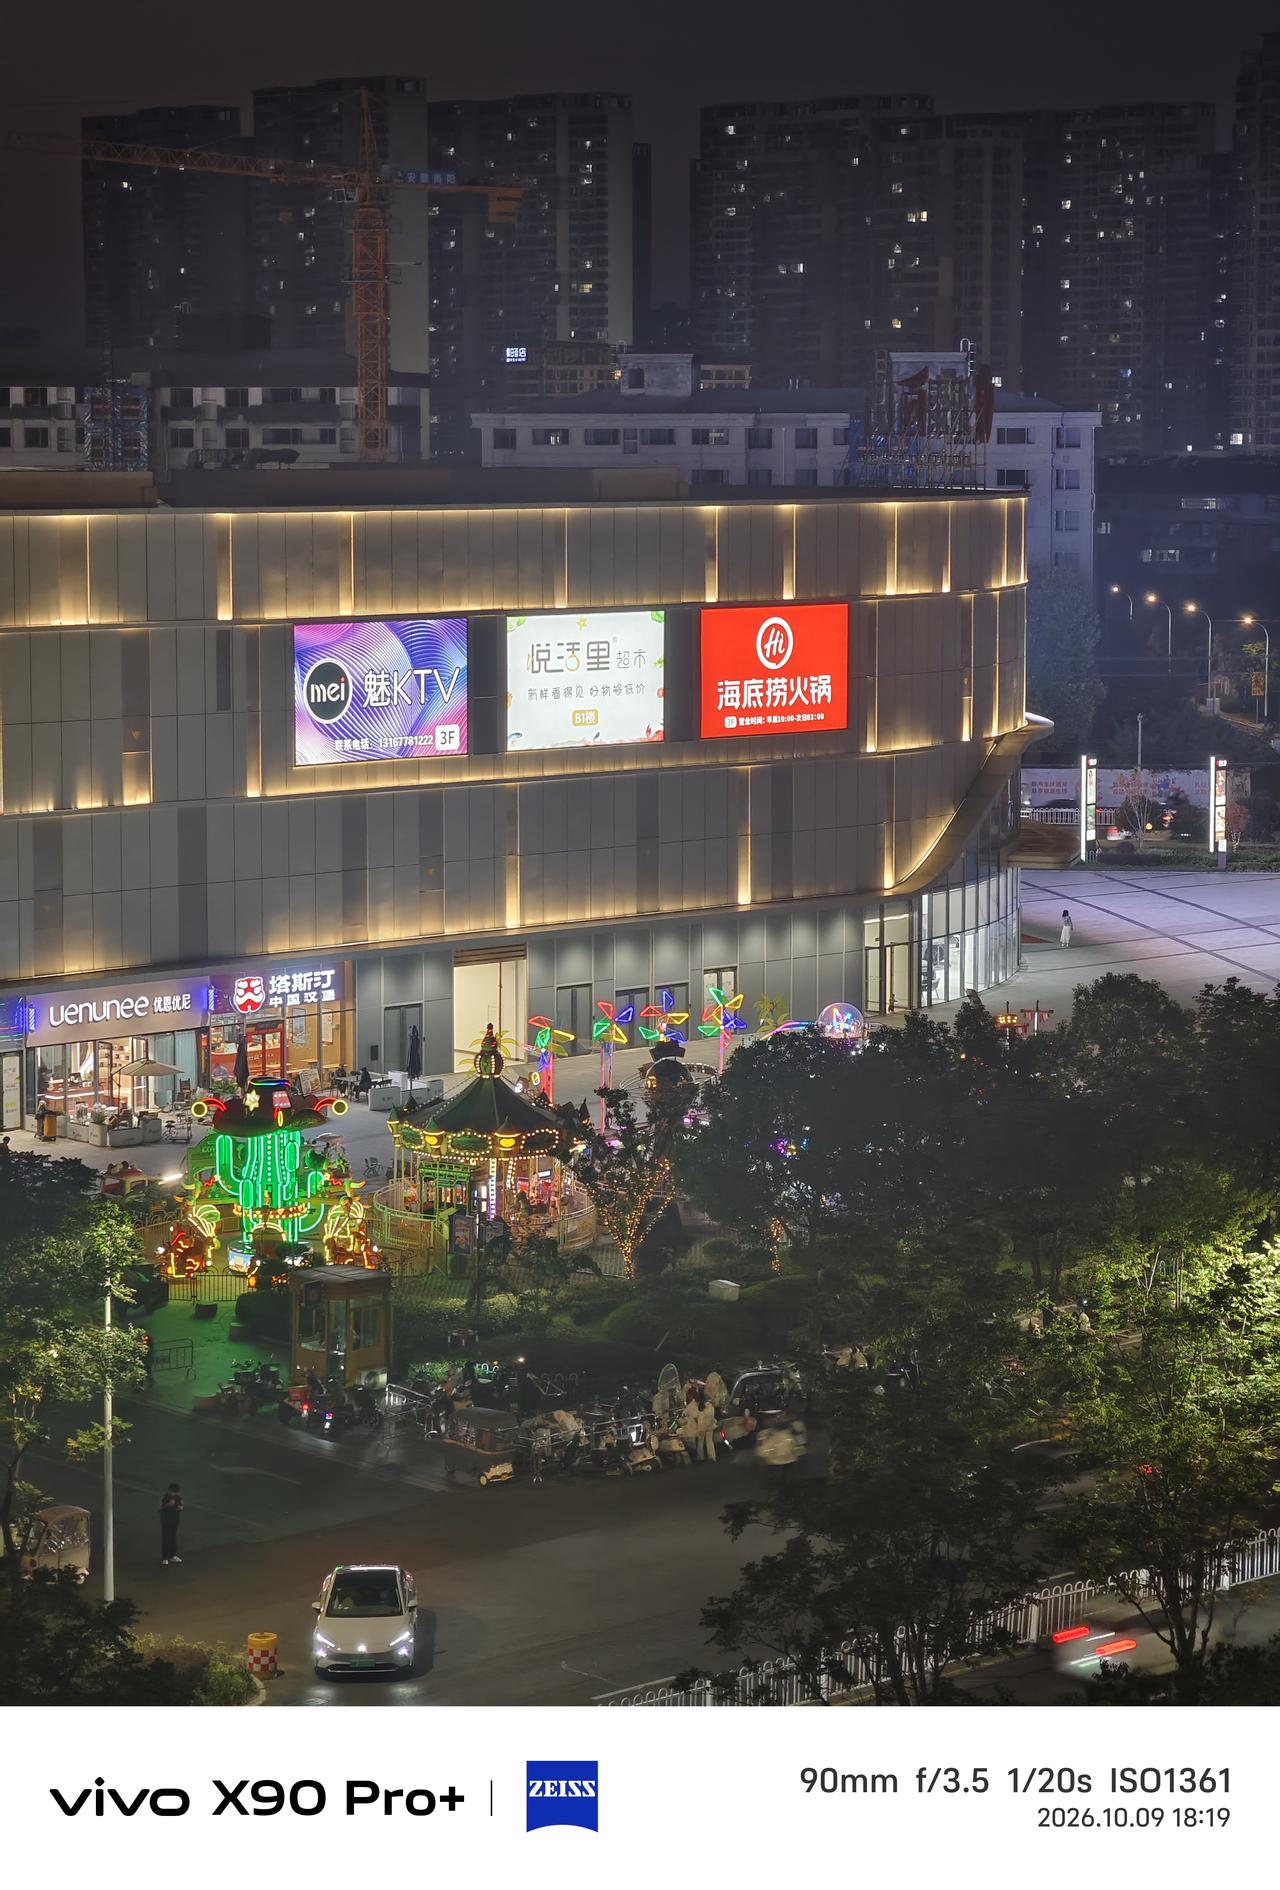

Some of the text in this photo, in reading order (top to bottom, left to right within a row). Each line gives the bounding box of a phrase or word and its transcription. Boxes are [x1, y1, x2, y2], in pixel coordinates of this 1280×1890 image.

[764, 627, 785, 658] Hi
[527, 641, 610, 673] 悦活里
[617, 649, 647, 669] 超市
[311, 677, 345, 702] mei
[363, 668, 459, 708] 魅KTV
[528, 686, 583, 702] 新鲜看得见
[717, 675, 831, 710] 海底捞火锅
[378, 735, 433, 747] 13167781222
[440, 730, 455, 745] 3F
[269, 970, 335, 994] 塔斯汀
[269, 989, 336, 1007] 中国汉堡
